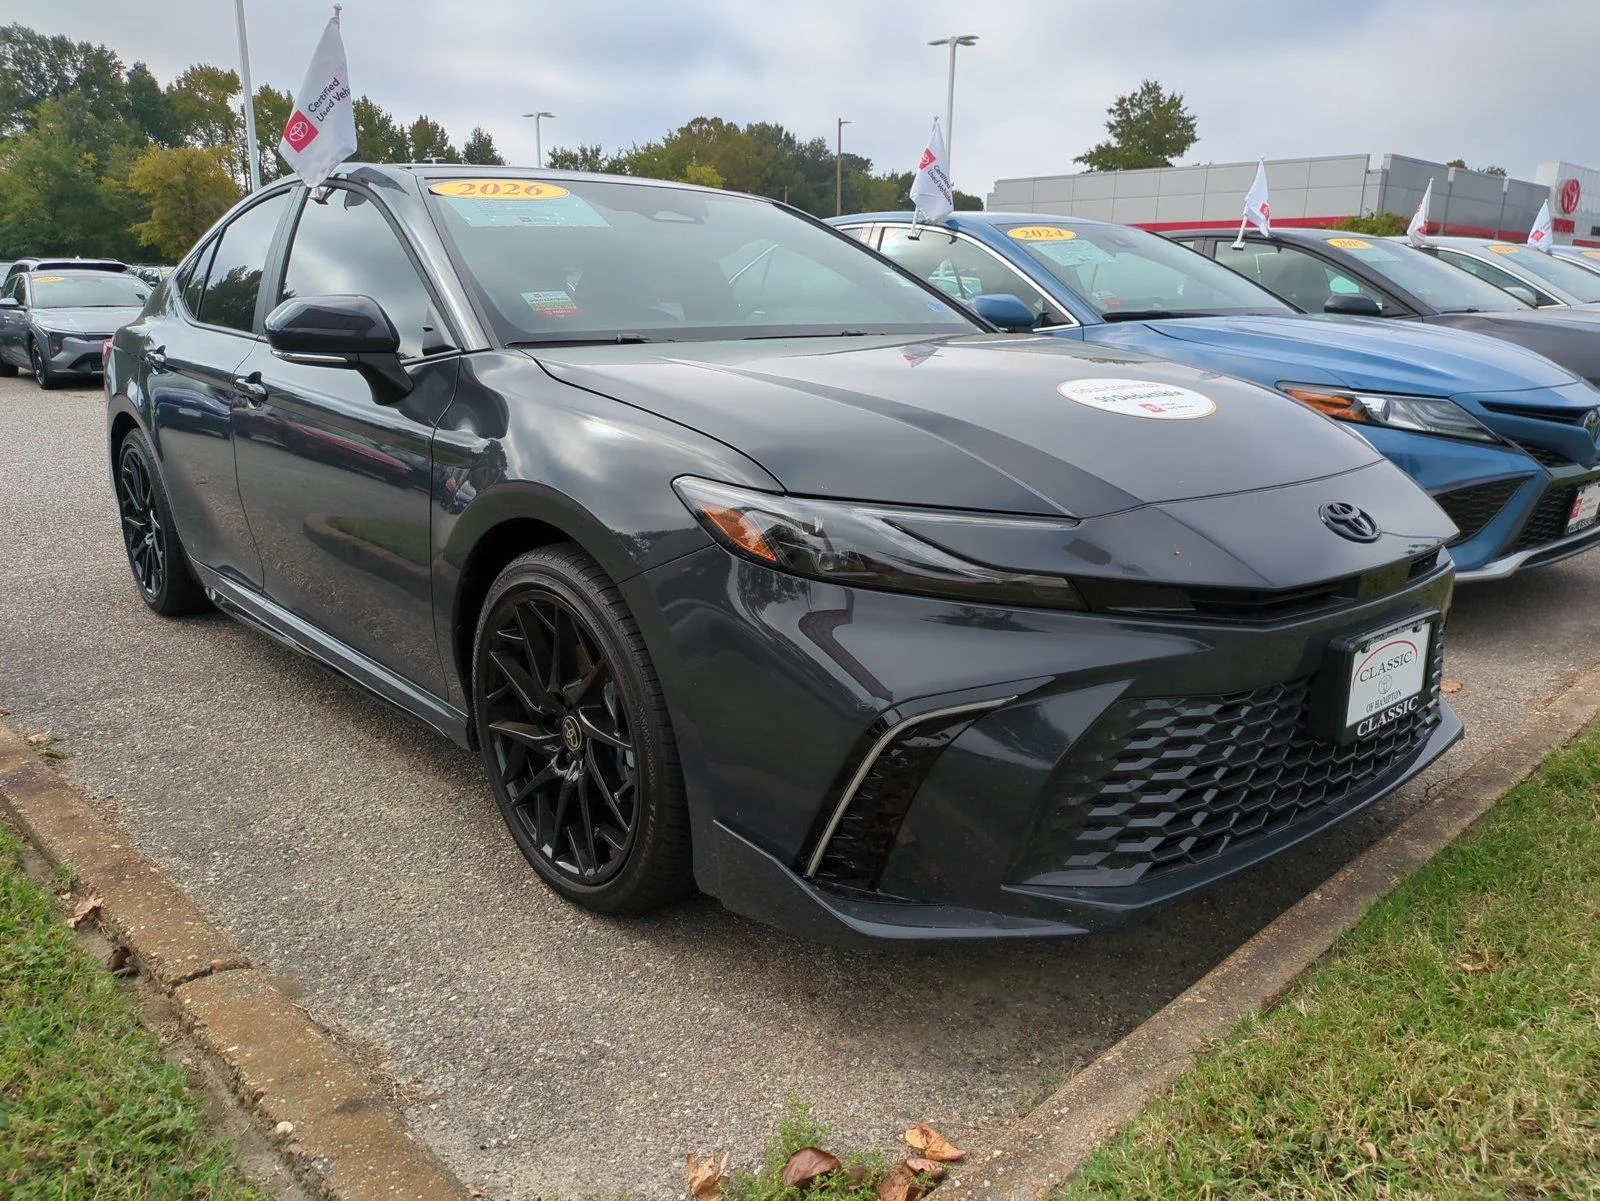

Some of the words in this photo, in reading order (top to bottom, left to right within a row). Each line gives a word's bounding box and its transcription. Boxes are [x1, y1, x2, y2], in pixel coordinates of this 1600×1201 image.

[308, 77, 340, 112] Certified
[316, 99, 335, 122] Used
[459, 183, 543, 196] 2026
[1020, 229, 1064, 238] 2024
[1360, 650, 1412, 682] CLASSIC
[1366, 702, 1375, 713] OF
[1374, 688, 1402, 709] HAMPTON
[1357, 695, 1419, 737] CLASSIC
